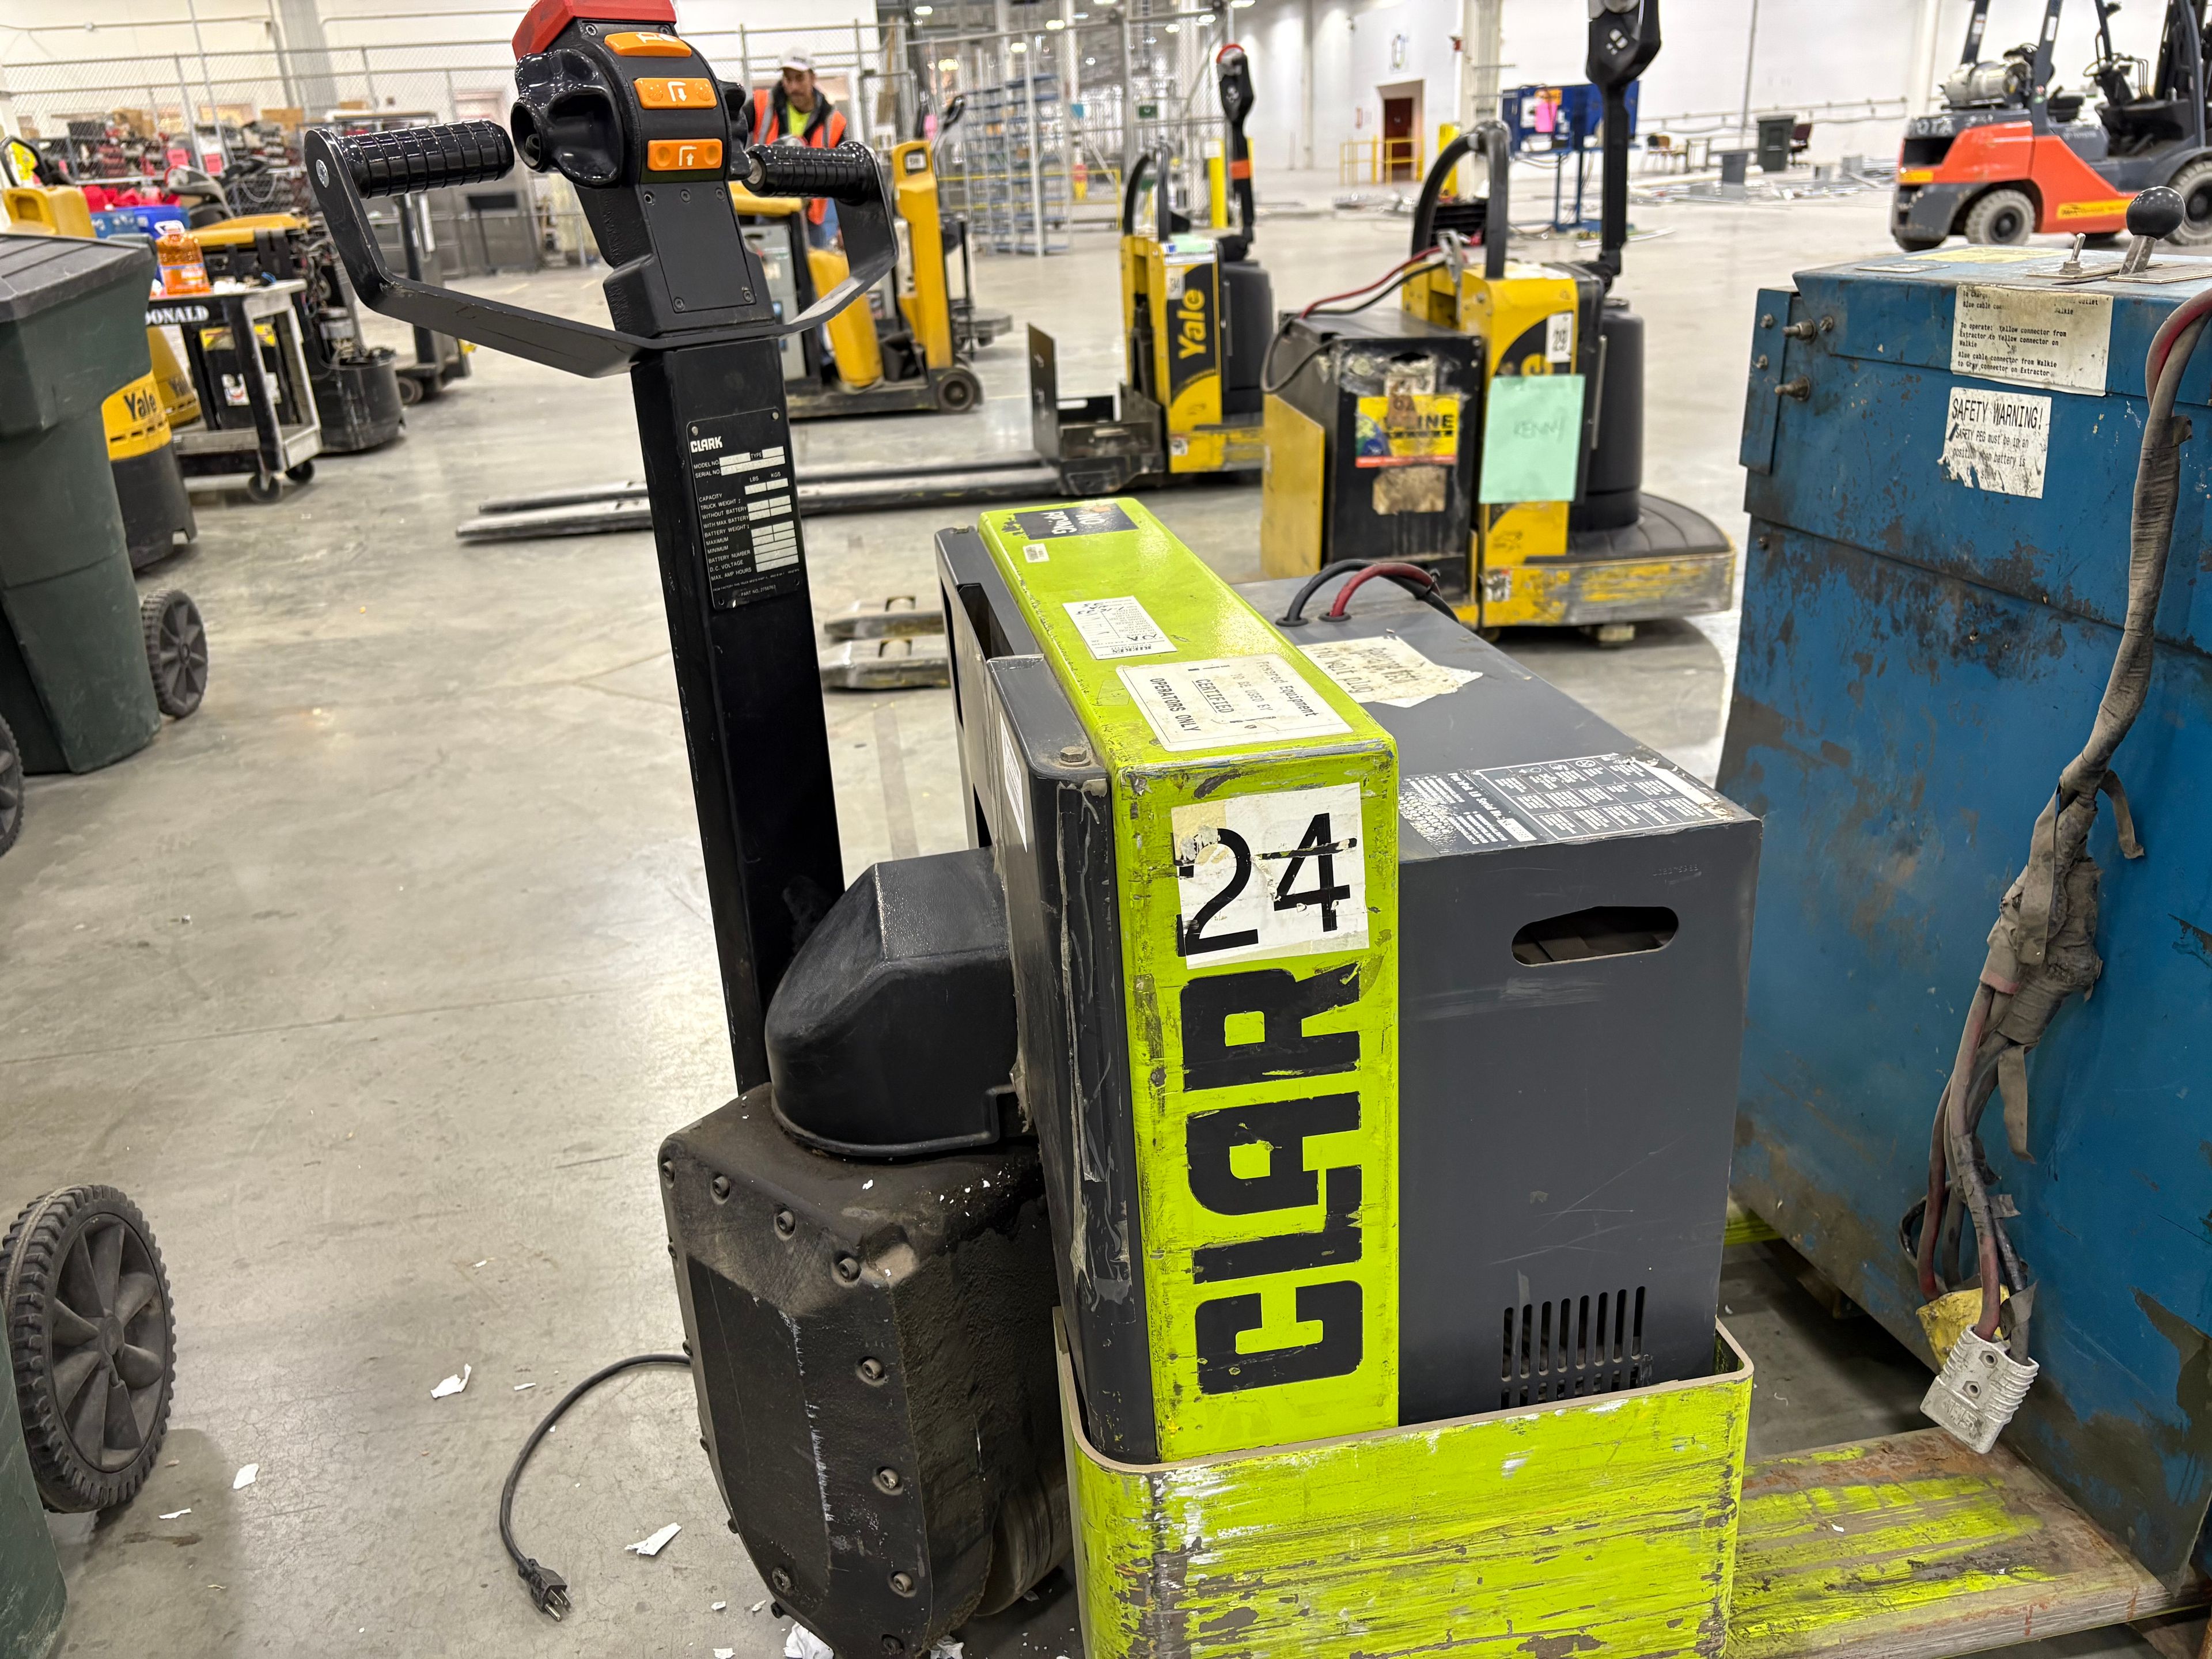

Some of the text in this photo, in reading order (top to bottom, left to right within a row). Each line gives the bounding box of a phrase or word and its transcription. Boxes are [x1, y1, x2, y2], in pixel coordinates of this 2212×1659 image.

[1176, 288, 1206, 359] Yale
[1969, 324, 1993, 332] operate:
[1999, 325, 2018, 334] Yellow
[2020, 327, 2050, 335] connector
[1960, 331, 1986, 339] Extractor
[1998, 332, 2017, 342] Yellow
[2020, 336, 2048, 344] connector
[1990, 355, 2018, 364] connector
[2037, 359, 2057, 368] Walkie
[1980, 363, 2008, 372] connector
[2020, 367, 2050, 376] Extractor
[123, 388, 157, 422] Yale
[1952, 397, 2043, 430] SAFETY WARNING!
[690, 435, 723, 453] CLARK
[1955, 427, 1974, 441] SAFETY
[1988, 434, 2001, 445] must
[2003, 435, 2010, 444] be
[2021, 439, 2029, 448] an
[1993, 454, 2017, 468] battery
[2019, 454, 2025, 467] is
[695, 471, 712, 479] SERIAL
[698, 493, 723, 502] CAPACITY
[700, 503, 717, 511] TRUCK
[718, 499, 736, 507] WEIGHT
[702, 506, 747, 520] WITHOUT BATTERY
[1075, 513, 1106, 525] NO
[703, 521, 715, 529] WITH
[728, 515, 749, 524] BATTERY
[704, 529, 726, 538] BATTERY
[728, 524, 746, 533] WEIGHT
[706, 536, 729, 546] MAXIMUM
[707, 545, 729, 554] MINIMUM
[708, 550, 751, 564] BATTERY NUMBER
[721, 559, 744, 570] VOLTAGE
[736, 567, 752, 575] HOURS
[1311, 646, 1374, 694] 110 volt plug
[1194, 679, 1235, 714] CERTIFIED
[1244, 689, 1266, 703] USED
[1279, 684, 1320, 717] Equipment
[1149, 678, 1202, 732] OPERATORS ONLY
[1177, 813, 1351, 957] 24
[1180, 963, 1363, 1395] CLAR
